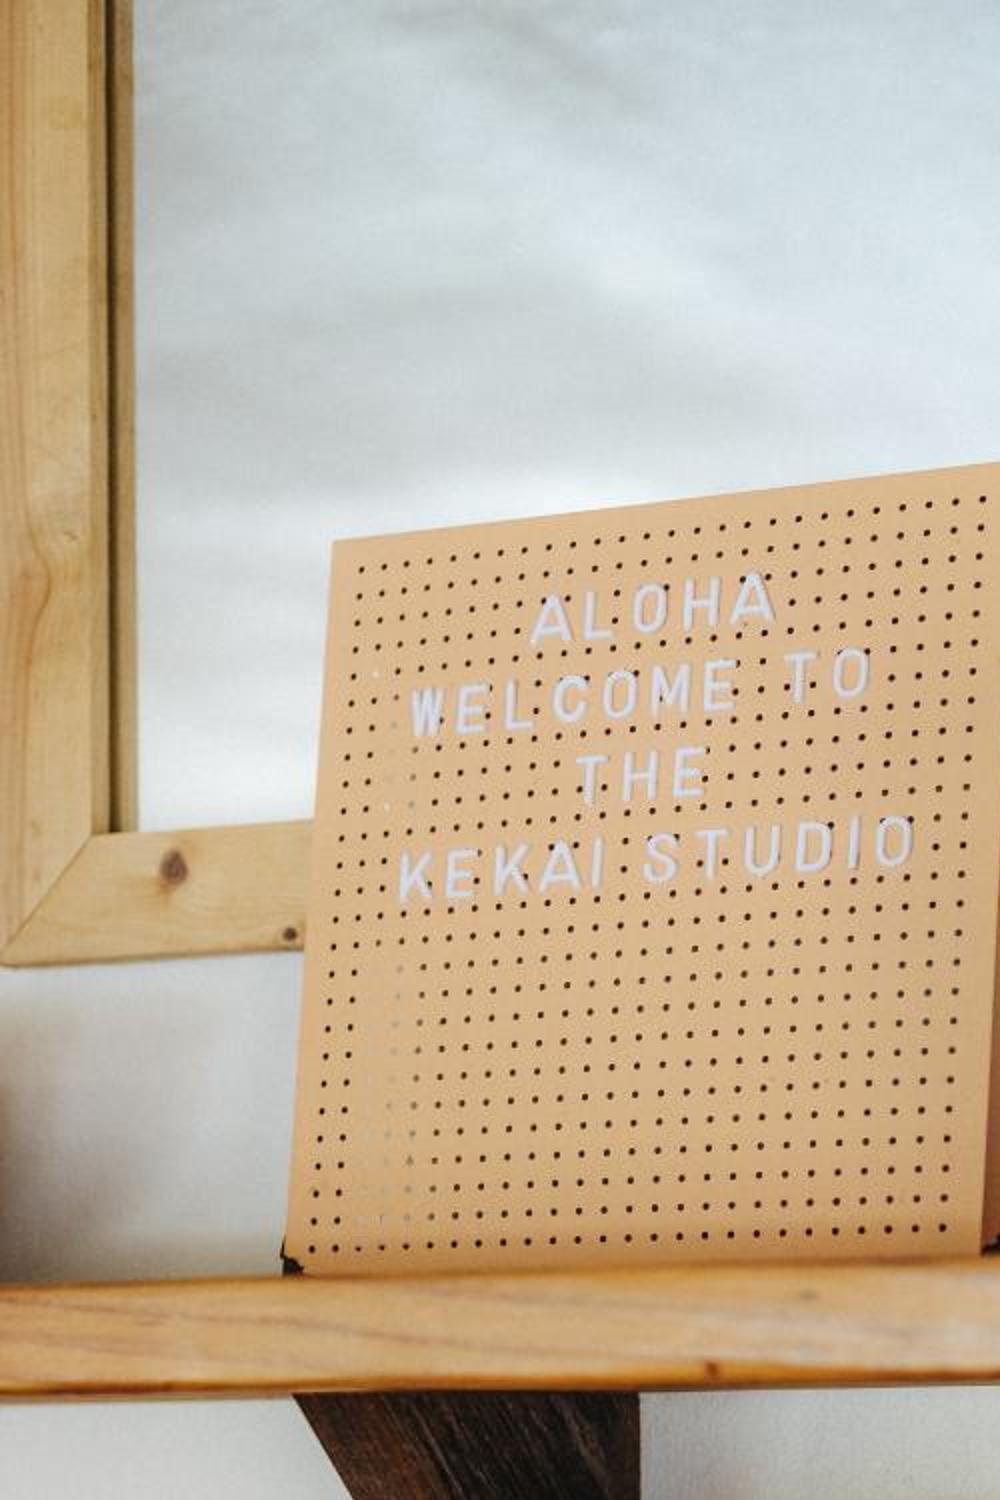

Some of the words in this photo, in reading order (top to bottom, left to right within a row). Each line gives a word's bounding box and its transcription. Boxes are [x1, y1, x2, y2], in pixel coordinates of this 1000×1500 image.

[530, 570, 776, 645] ALOHA
[411, 658, 738, 737] WELCOME
[784, 648, 870, 704] TO
[576, 746, 706, 806] THE
[399, 839, 604, 901] KEKAI
[643, 815, 914, 884] STUDIO
